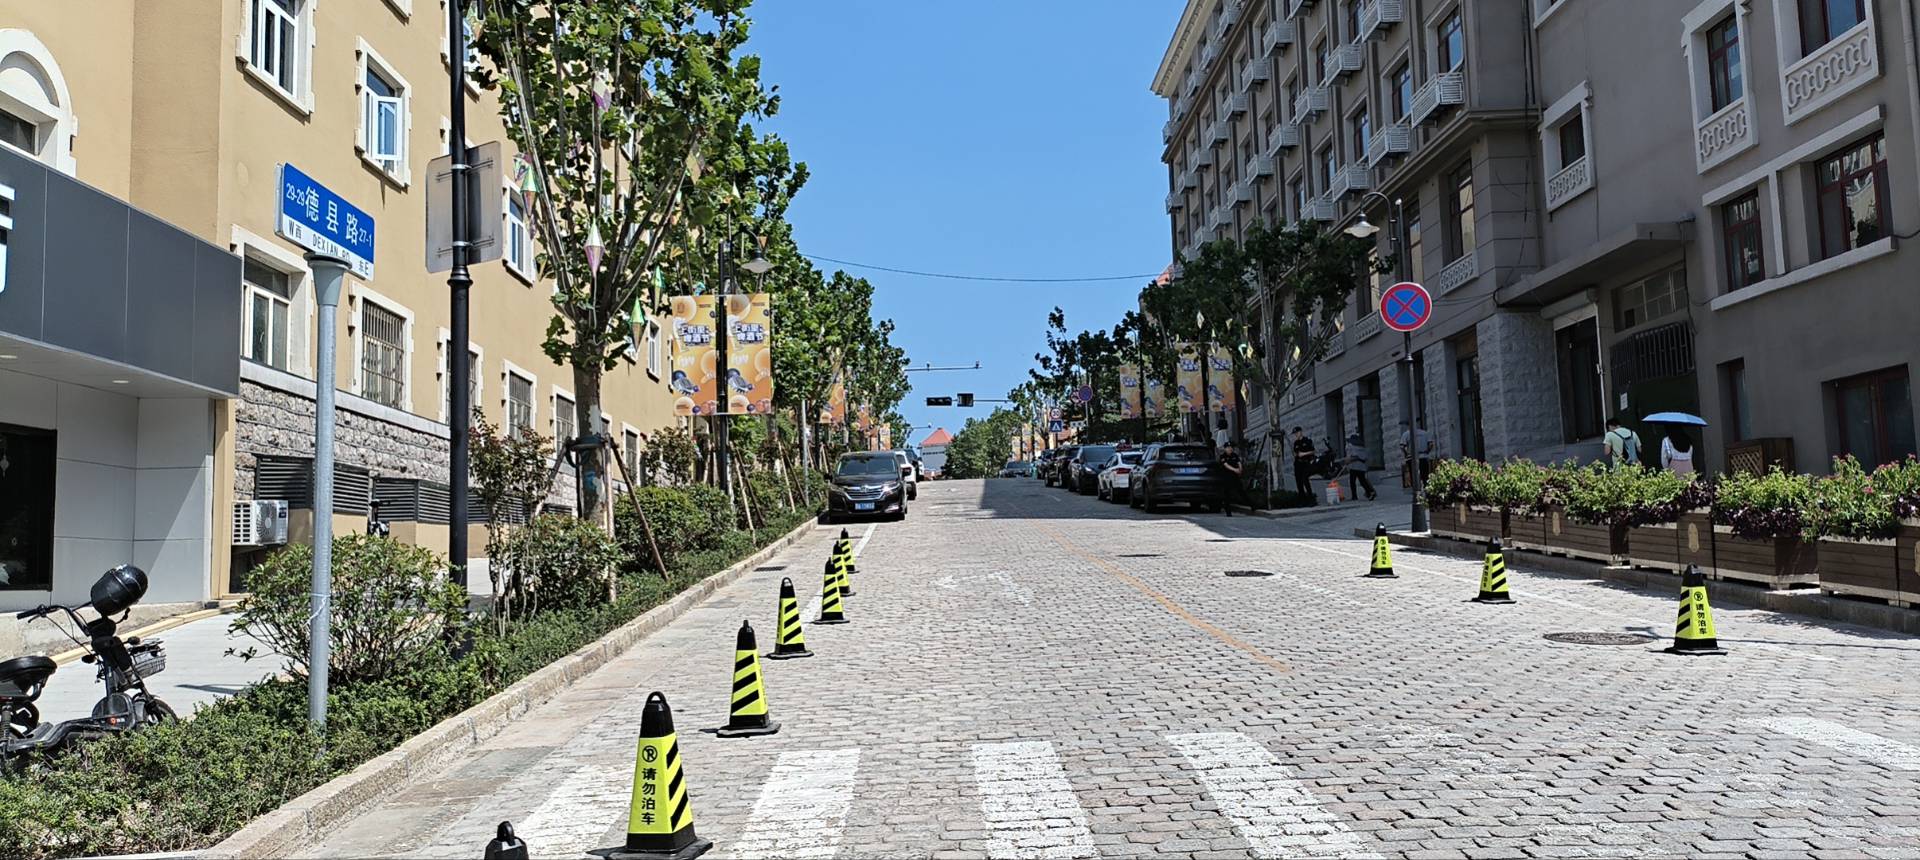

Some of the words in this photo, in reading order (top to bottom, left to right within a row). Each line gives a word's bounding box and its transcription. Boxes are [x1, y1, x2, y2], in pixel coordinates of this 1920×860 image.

[305, 186, 359, 246] 德县路
[359, 228, 372, 247] 27-1
[312, 233, 339, 256] DEXIAN
[641, 767, 657, 826] 请勿泊车
